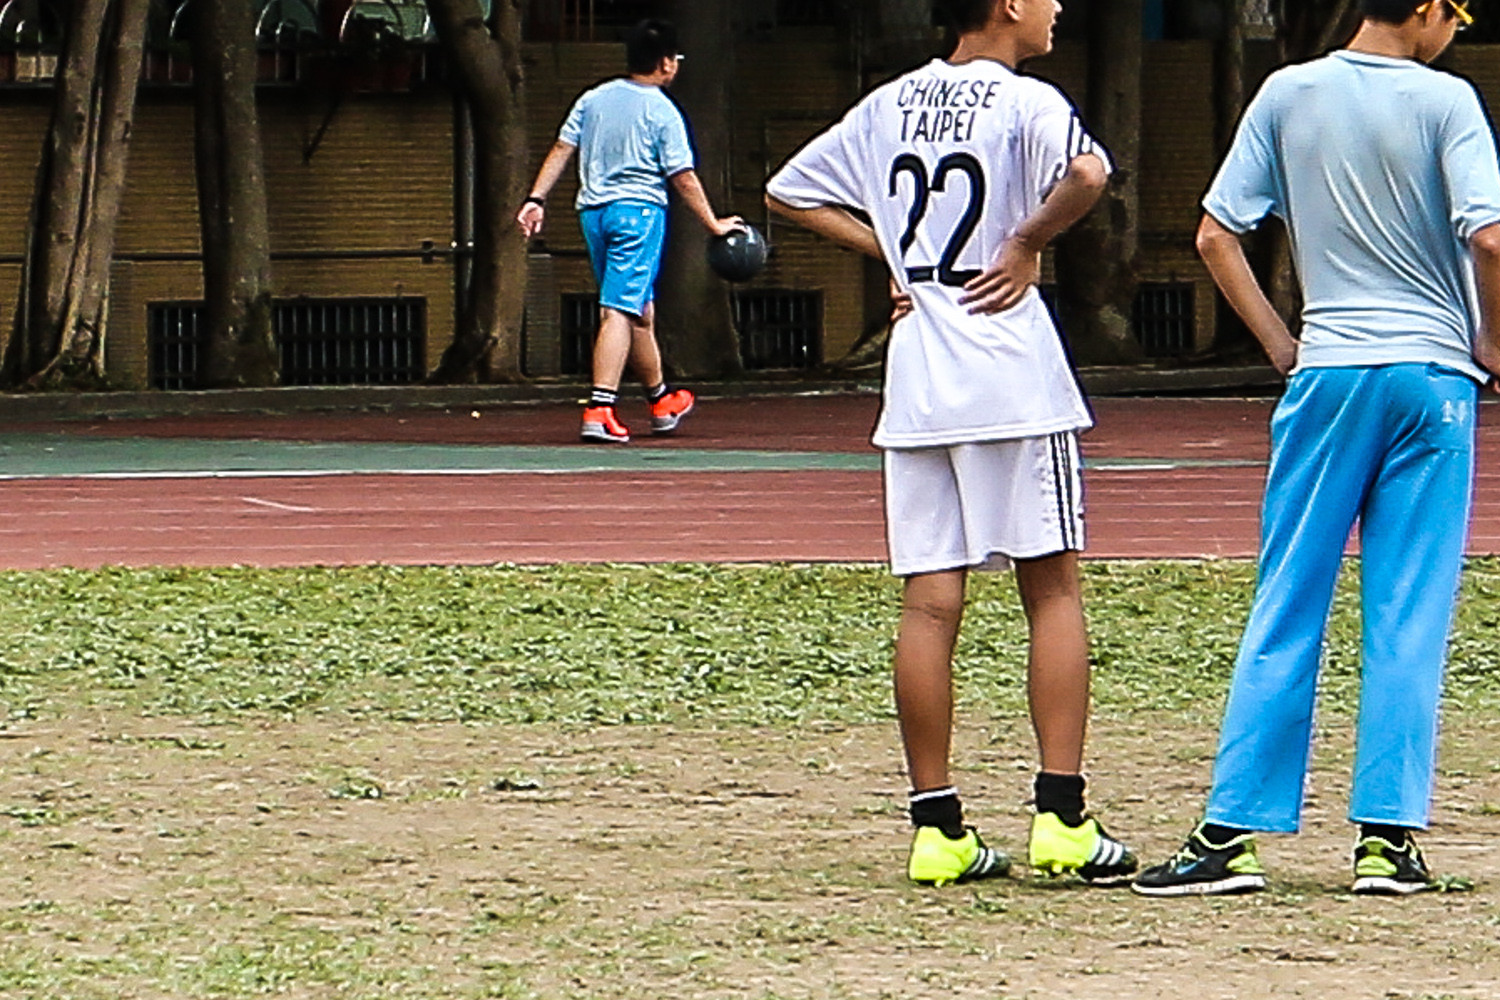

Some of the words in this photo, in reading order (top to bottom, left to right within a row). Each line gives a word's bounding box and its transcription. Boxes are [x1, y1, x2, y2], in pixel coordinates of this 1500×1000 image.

[897, 78, 1001, 108] CHINESE
[900, 110, 976, 143] TAIPEI
[888, 151, 986, 287] 22
